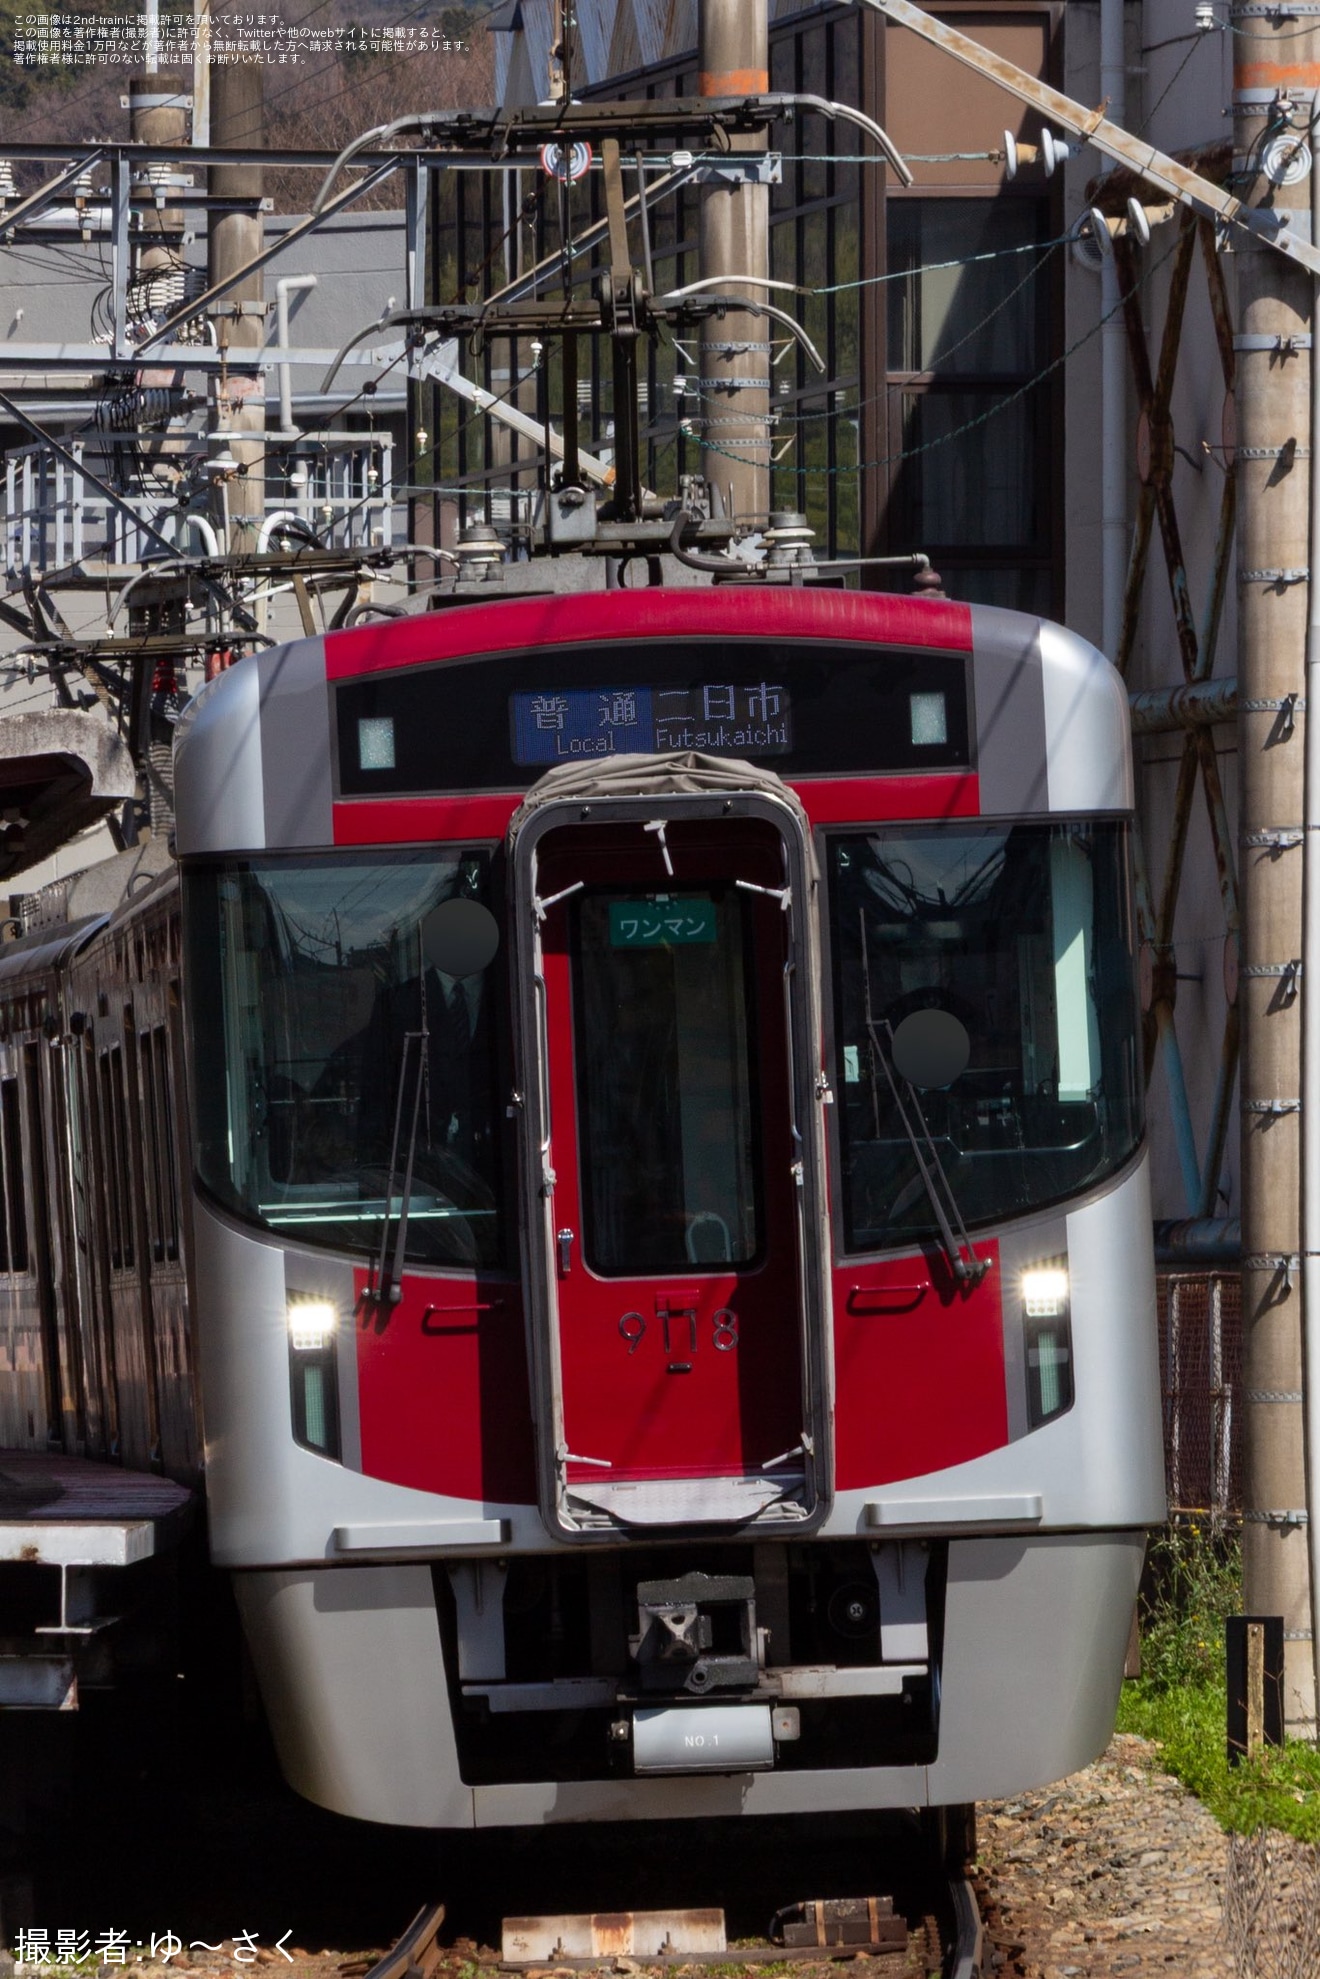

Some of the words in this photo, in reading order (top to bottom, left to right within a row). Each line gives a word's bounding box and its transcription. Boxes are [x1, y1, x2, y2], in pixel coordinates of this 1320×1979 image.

[530, 692, 638, 730] 普通
[656, 682, 784, 722] 二日市
[557, 731, 616, 754] Local
[656, 723, 788, 749] Futsukaichi
[620, 919, 706, 939] ワンマン
